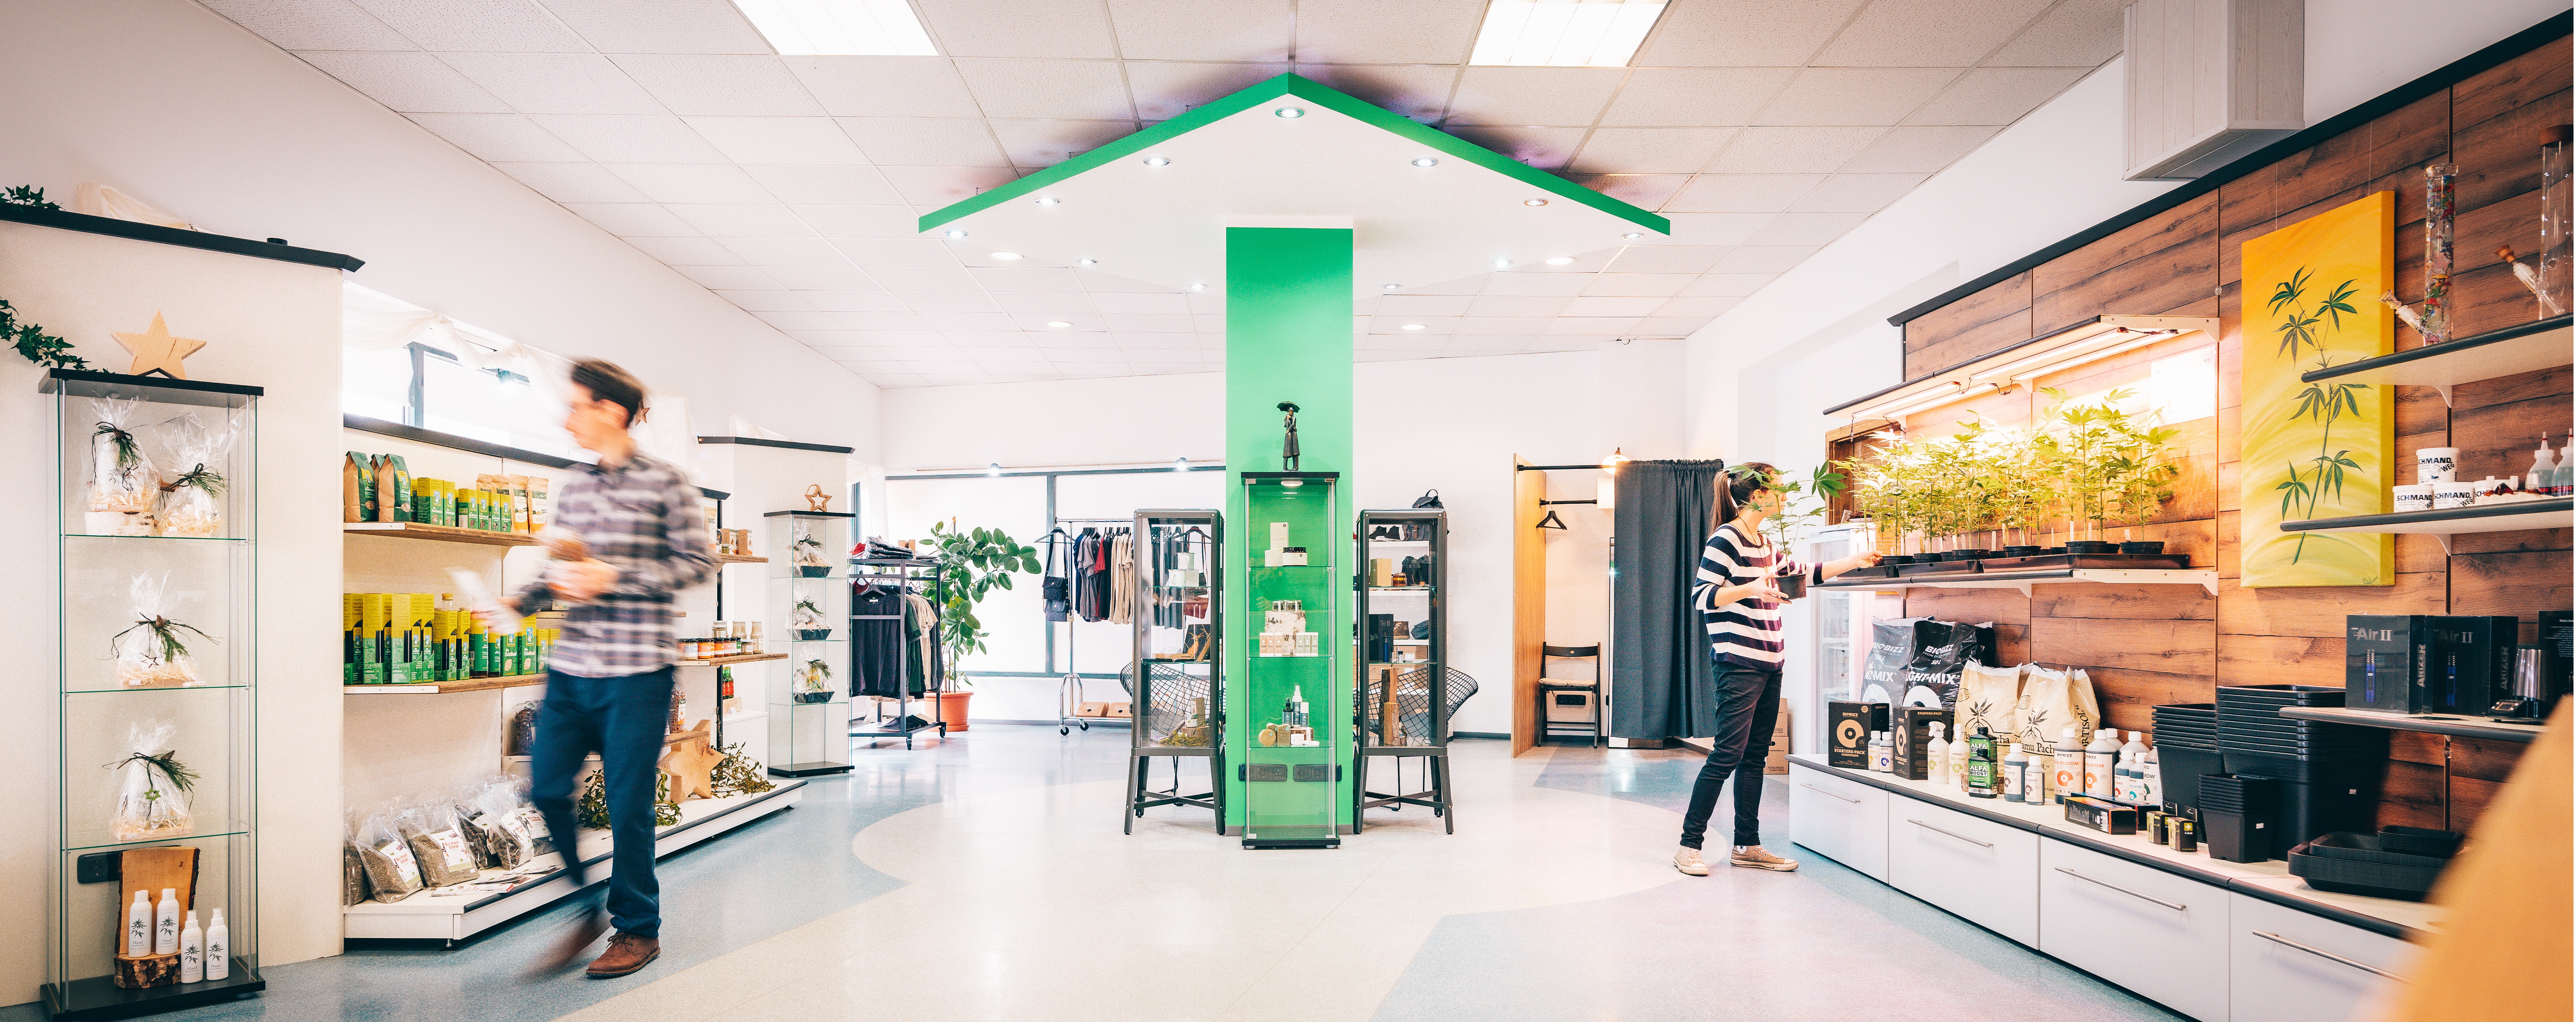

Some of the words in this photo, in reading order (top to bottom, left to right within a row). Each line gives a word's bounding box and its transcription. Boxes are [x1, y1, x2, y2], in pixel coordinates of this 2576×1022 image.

[2441, 462, 2454, 472] WEG
[2460, 497, 2473, 507] WEG
[2357, 628, 2378, 641] Air
[2380, 630, 2392, 641] II
[2461, 632, 2473, 643] II
[1925, 644, 1954, 654] BIOBIZZ
[2416, 644, 2426, 687] ARIZER
[2500, 646, 2509, 690] ARIZER
[1996, 735, 2010, 743] cha
[2036, 743, 2055, 754] Pach
